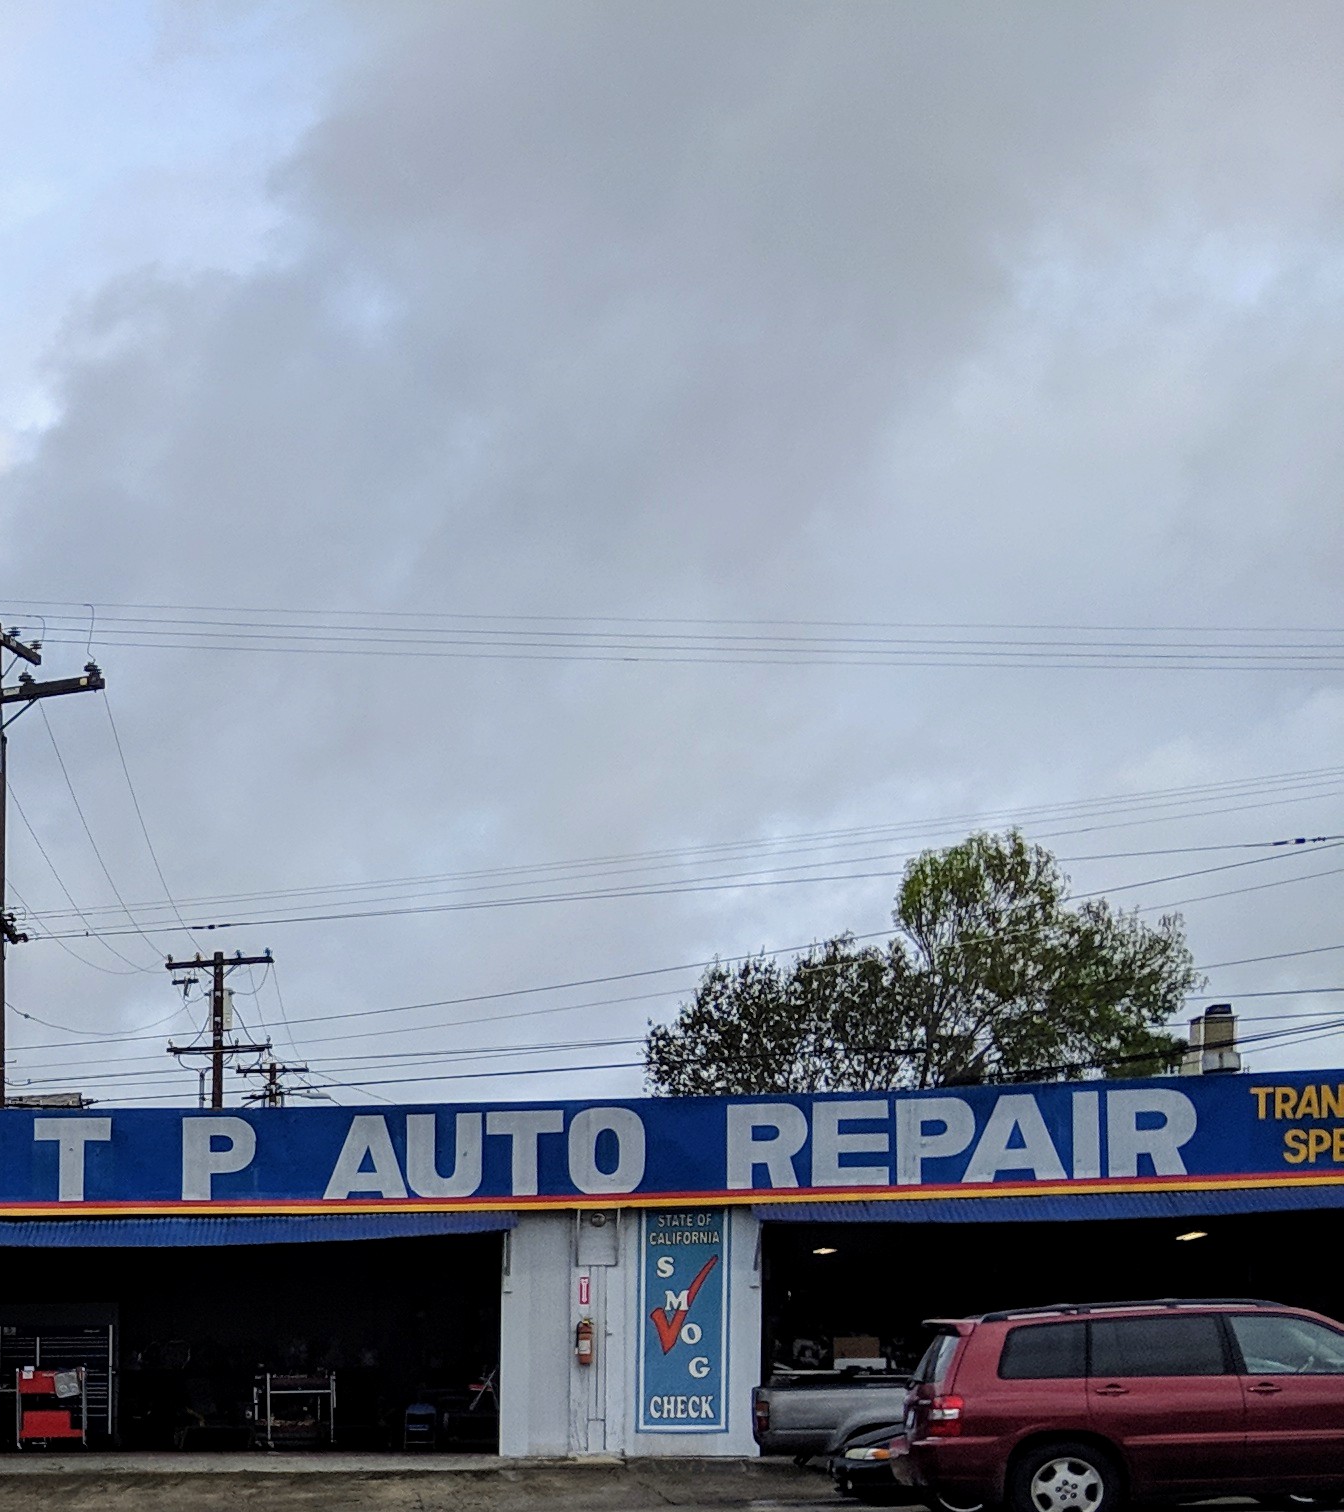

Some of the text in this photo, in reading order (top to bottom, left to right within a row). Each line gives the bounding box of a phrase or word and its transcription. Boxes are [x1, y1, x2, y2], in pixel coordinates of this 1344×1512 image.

[33, 1087, 1198, 1202] T P AUTO REPAIR
[658, 1213, 712, 1228] STATE OF
[649, 1231, 720, 1245] CALIFORNIA
[656, 1256, 711, 1379] SMOG
[649, 1395, 715, 1419] CHECK
